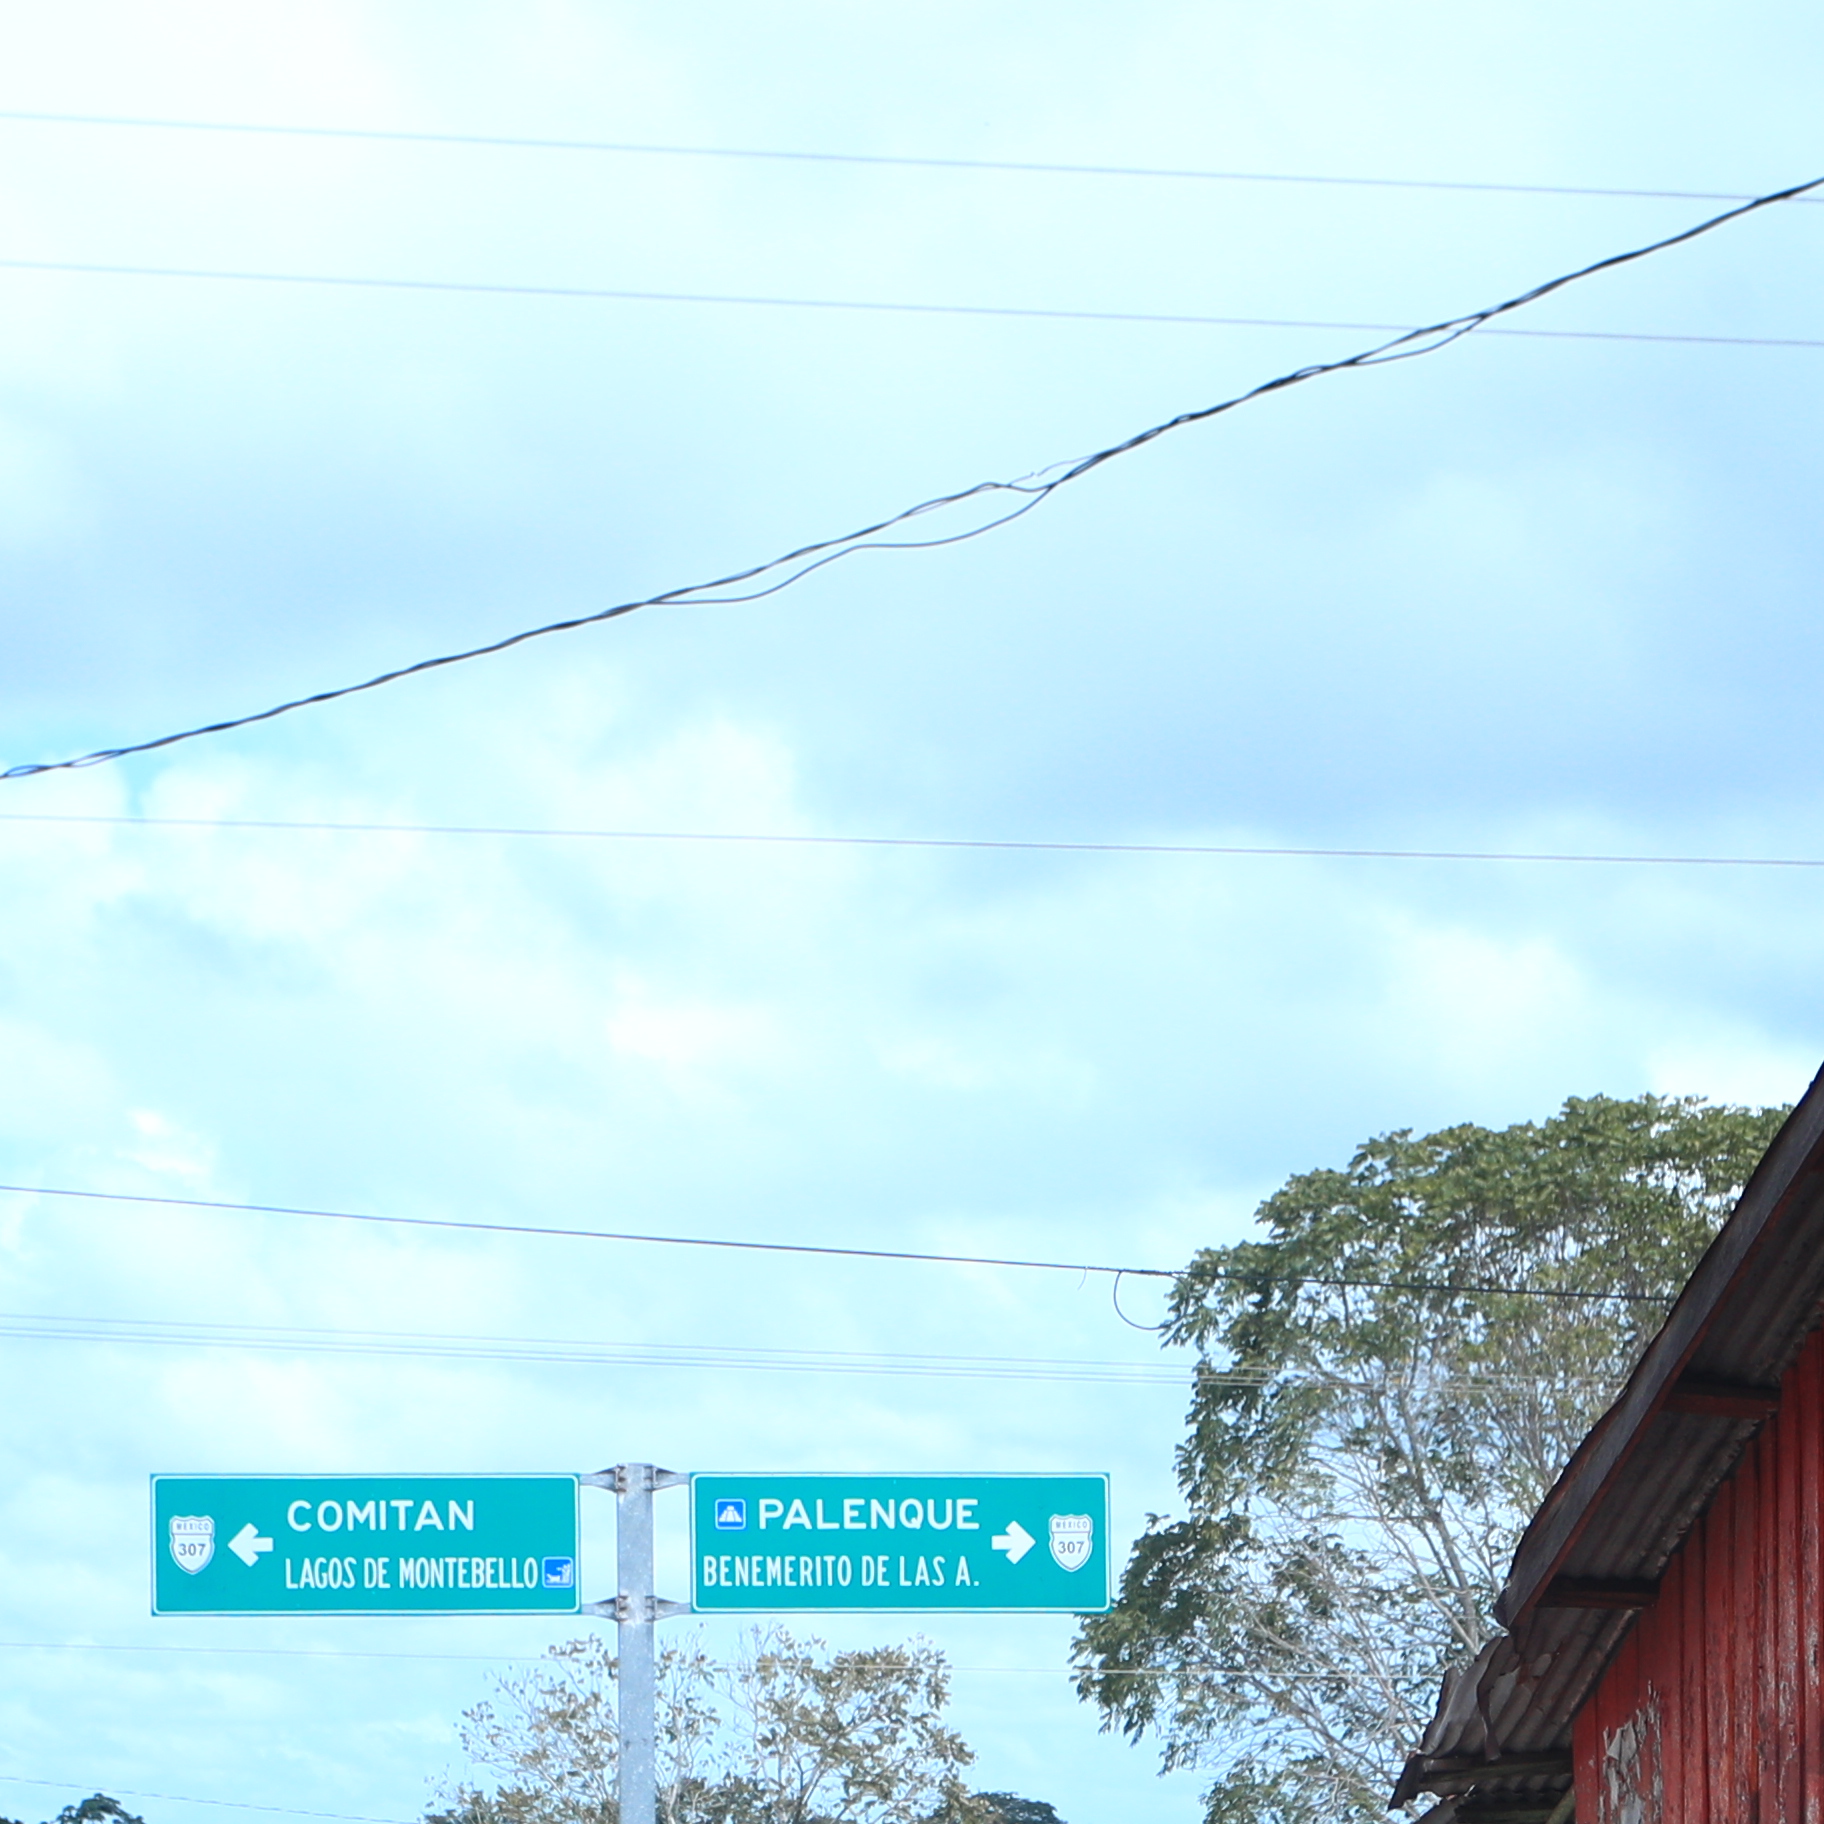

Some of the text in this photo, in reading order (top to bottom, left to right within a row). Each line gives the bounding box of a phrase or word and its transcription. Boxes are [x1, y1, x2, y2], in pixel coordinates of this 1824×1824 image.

[287, 1499, 475, 1532] COMITAN
[758, 1498, 980, 1530] PALENQUE
[178, 1543, 207, 1556] 307
[1057, 1541, 1085, 1554] 307
[285, 1557, 539, 1589] LAGOS DE MONTEBELLO
[703, 1555, 980, 1587] BENEMERITO DE LAS A.
